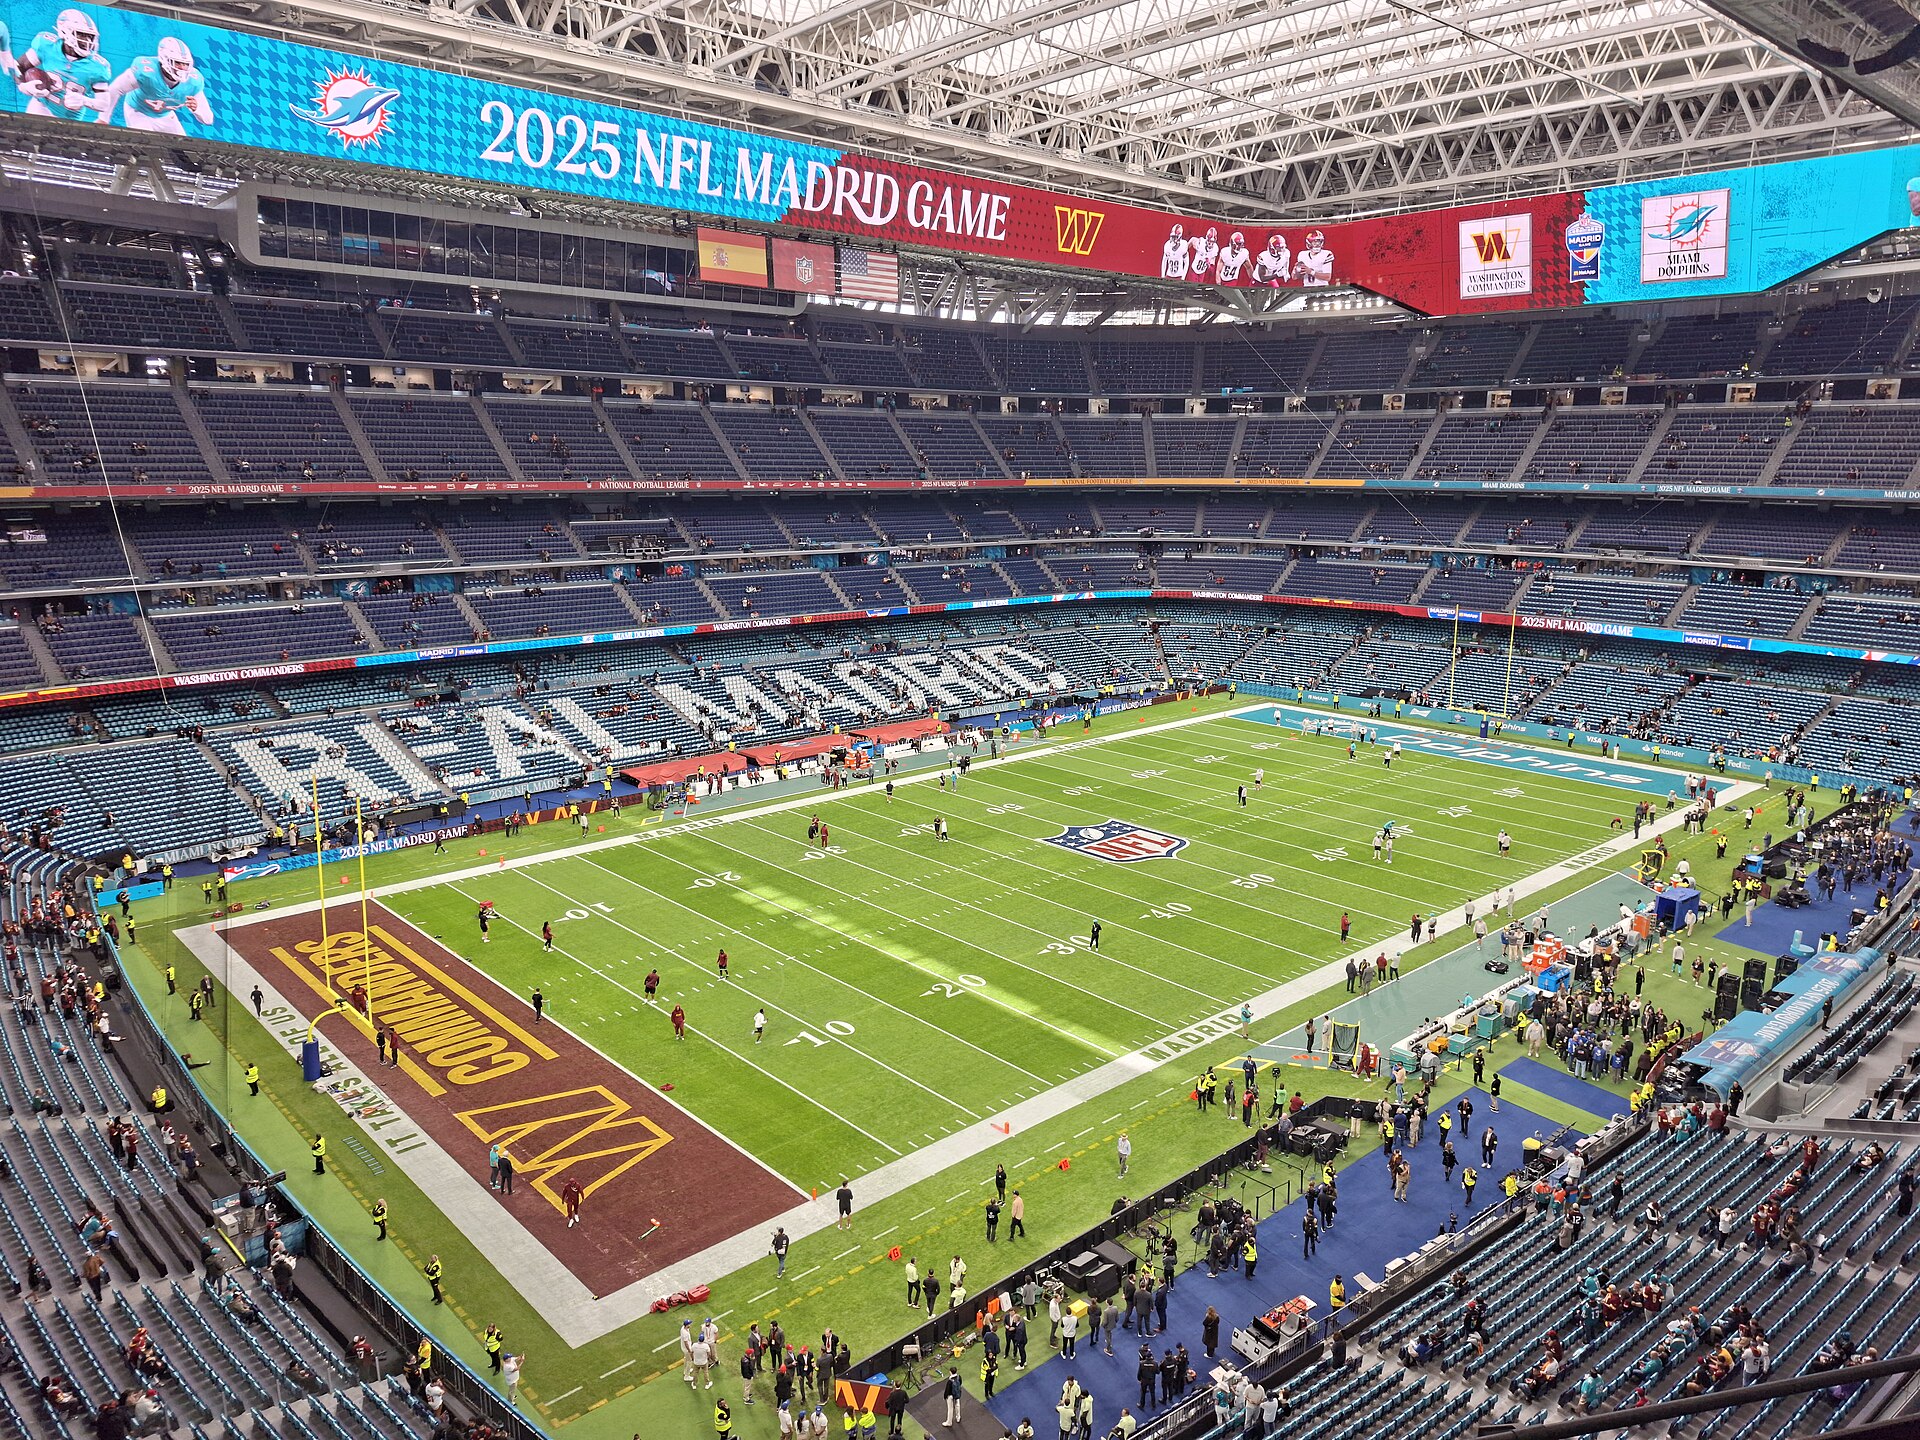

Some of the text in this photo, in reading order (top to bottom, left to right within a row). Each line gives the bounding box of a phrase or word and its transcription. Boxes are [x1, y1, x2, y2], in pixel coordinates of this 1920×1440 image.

[479, 100, 1011, 241] 2025 NFL MADRID GAME
[1568, 234, 1602, 245] MADRID
[1667, 253, 1700, 265] MIAMI
[797, 266, 814, 282] NFL
[1223, 266, 1237, 279] 54
[1468, 271, 1524, 284] WASHINGTON
[1658, 263, 1710, 277] DOLPHINS
[1466, 280, 1527, 294] COMMANDERS
[188, 484, 284, 494] 2025 NFL MADRID GAME
[599, 481, 690, 489] NATIONAL FOOTBALL LEAGUE
[1657, 484, 1673, 492] 2025
[1686, 485, 1711, 494] MADRID
[1711, 486, 1731, 494] GAME
[1884, 490, 1907, 498] MIAMI
[1192, 591, 1264, 601] WASHINGTON COMMANDERS
[1430, 607, 1456, 616] MADRID
[712, 617, 791, 632] WASHINGTON COMMANDERS
[1521, 616, 1634, 636] 2025 NFL MADRID GAME
[612, 628, 665, 640] MIAMI DOLPHINS
[1685, 636, 1718, 646] MADRID
[420, 648, 454, 657] MADRID
[173, 663, 305, 686] WASHINGTON COMMANDERS
[230, 645, 1066, 805] REAL MADRID
[1586, 735, 1602, 744] VISA
[1378, 734, 1652, 785] Dolphins
[1727, 759, 1751, 770] FedEx
[489, 786, 513, 800] 2025
[514, 782, 532, 796] NFL
[987, 803, 1025, 815] 50
[635, 817, 725, 842] MADRID
[370, 839, 393, 854] NFL
[393, 831, 436, 850] MADRID
[1083, 831, 1175, 861] NFL
[163, 846, 205, 864] MIAMI
[804, 845, 848, 862] 30
[692, 870, 742, 889] 20
[1229, 873, 1276, 889] 50
[565, 901, 615, 920] 10
[1150, 902, 1193, 920] 40
[1047, 935, 1097, 955] 30
[931, 973, 988, 999] 20
[261, 1006, 297, 1026] US
[294, 931, 532, 1086] COMMANDERS
[800, 1020, 856, 1048] 10
[1139, 1012, 1243, 1063] MADRID
[384, 1132, 428, 1155] IT
[1572, 1215, 1581, 1224] 12
